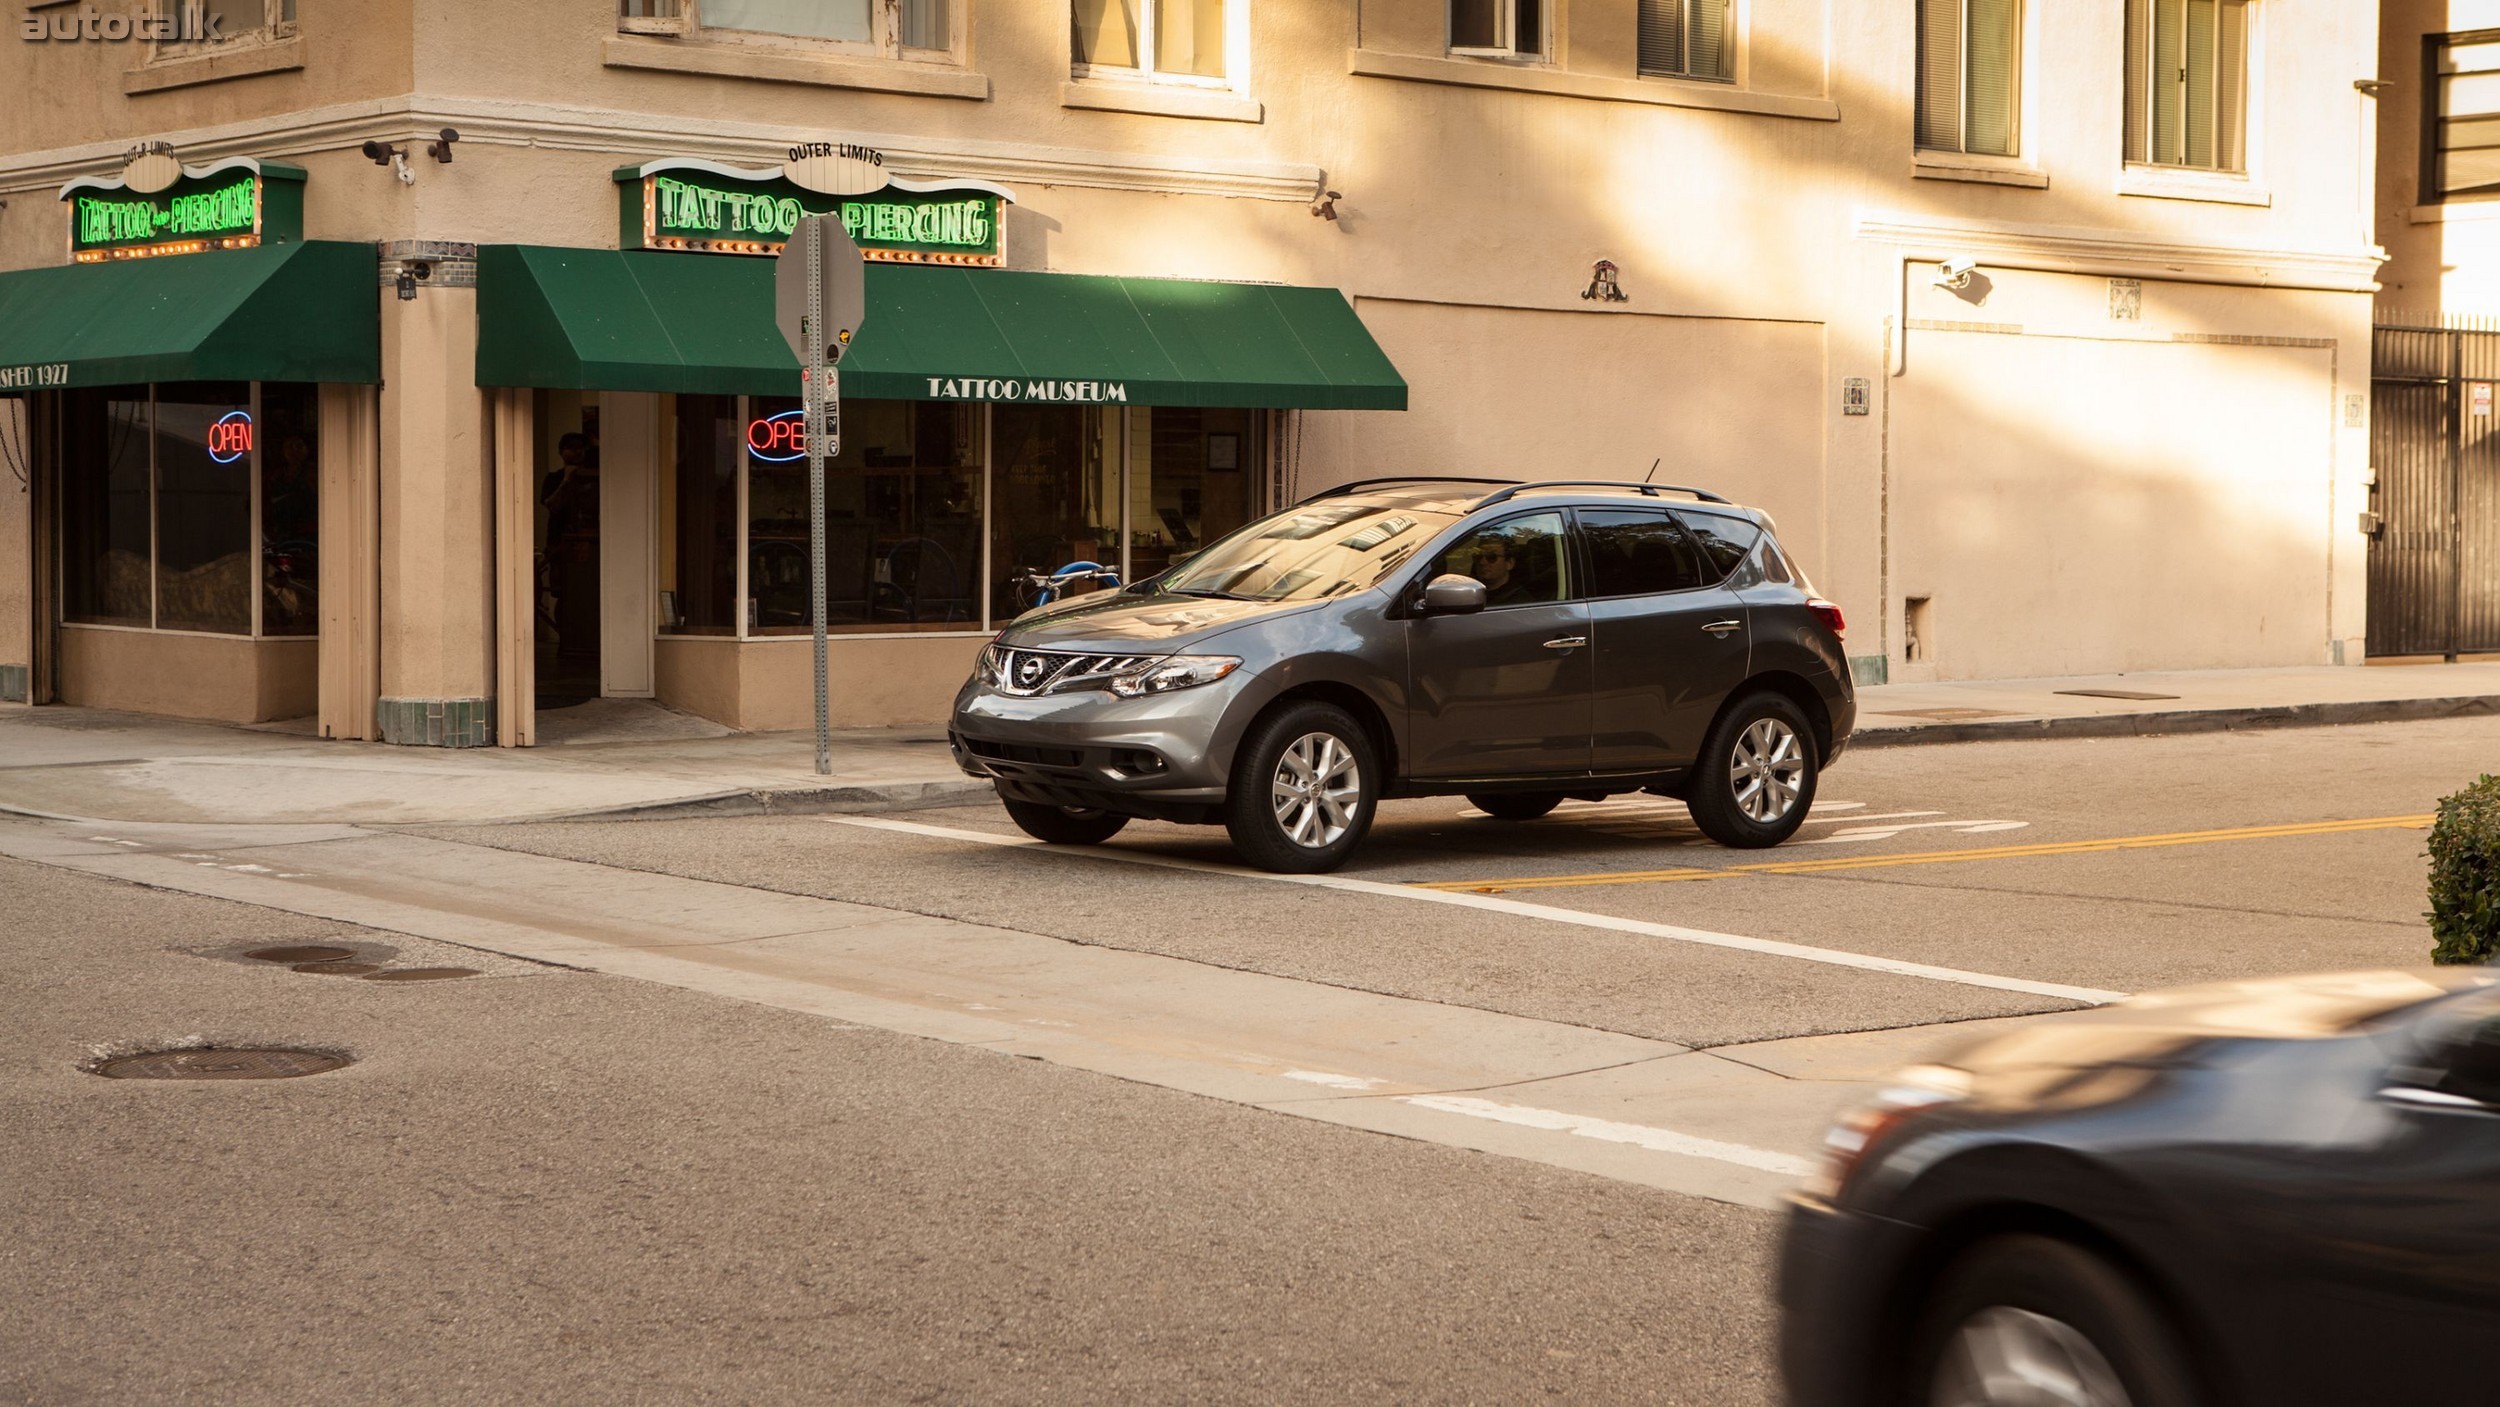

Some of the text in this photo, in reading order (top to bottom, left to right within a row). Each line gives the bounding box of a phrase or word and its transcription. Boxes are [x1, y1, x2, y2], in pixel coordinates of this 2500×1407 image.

[150, 141, 175, 160] LIMITS
[789, 142, 883, 167] OUTER LIMITS
[79, 197, 157, 243] TATTOO
[171, 177, 255, 233] PIERCING
[657, 177, 990, 247] TATTOO PIERCING
[0, 364, 69, 388] SHED 1927
[926, 378, 1128, 402] TATTOO MUSEUM
[208, 423, 252, 452] OPEN
[748, 419, 804, 451] OPE
